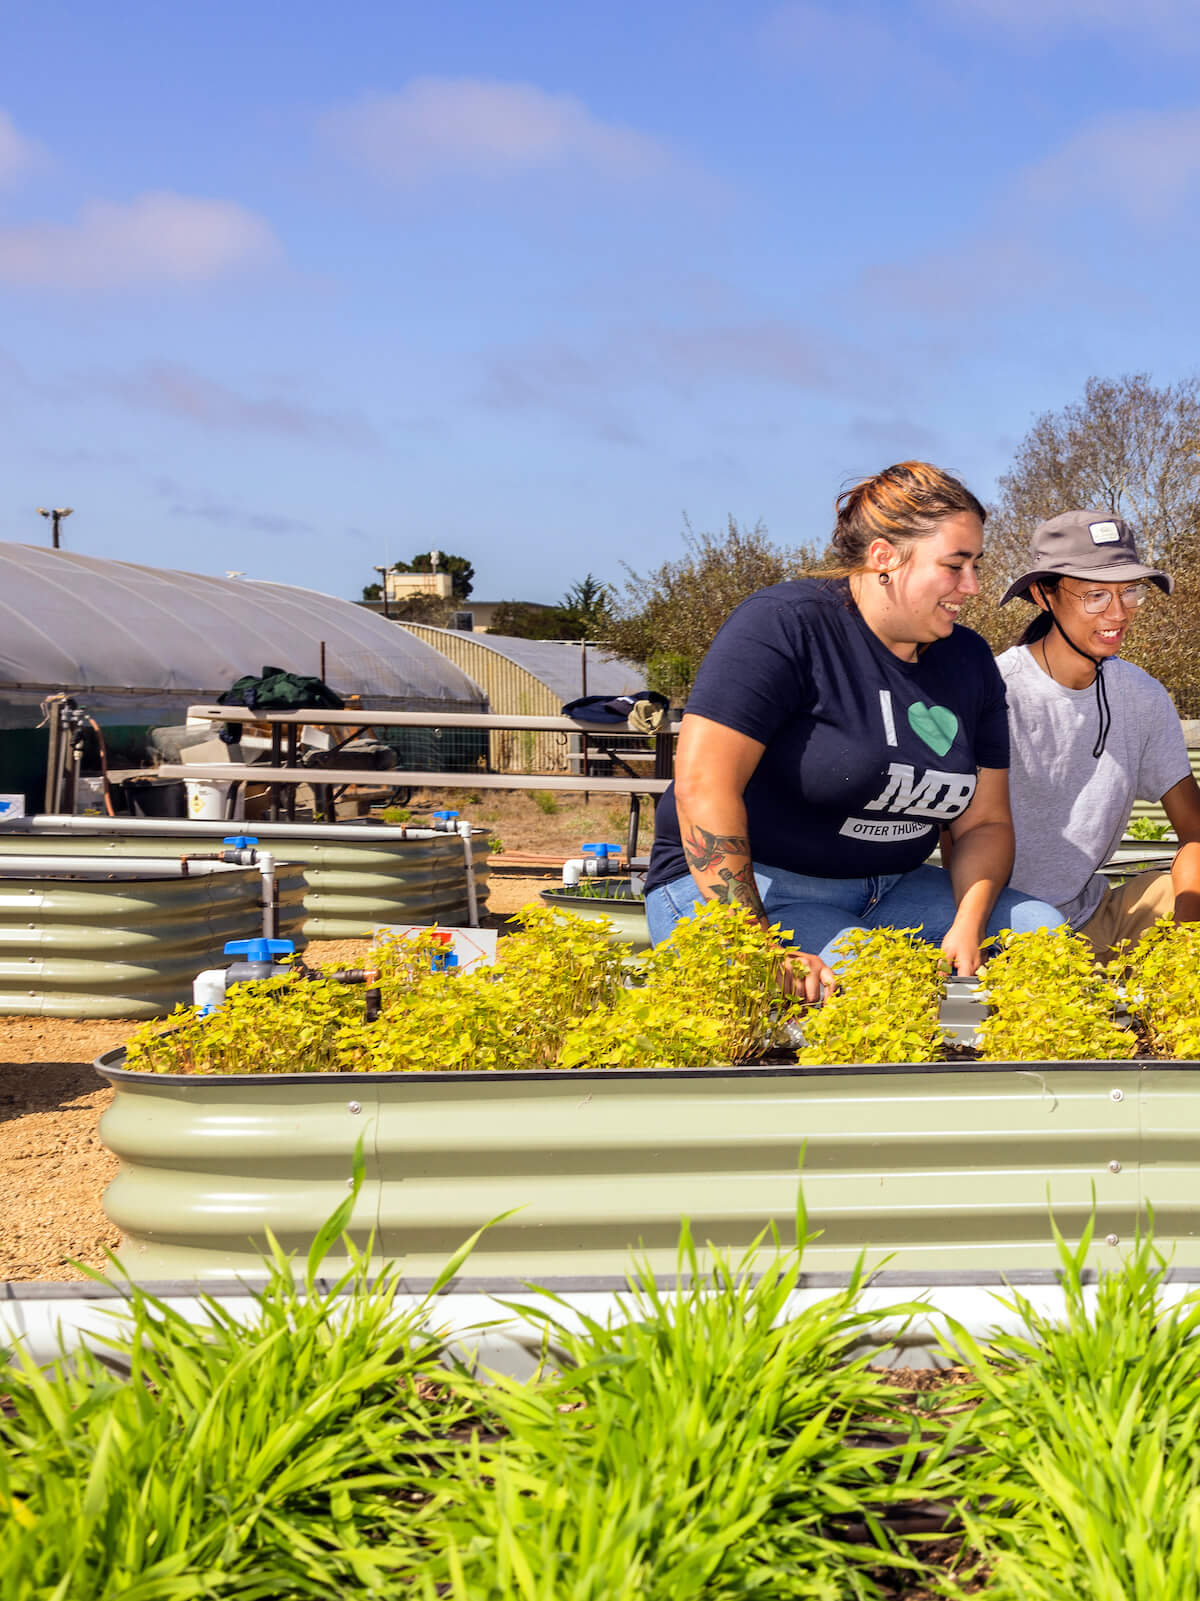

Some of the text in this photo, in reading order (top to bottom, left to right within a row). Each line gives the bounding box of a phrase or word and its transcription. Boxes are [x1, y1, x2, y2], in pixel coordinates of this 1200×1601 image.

[879, 690, 898, 747] I
[863, 762, 977, 819] MB
[853, 823, 889, 836] OTTER
